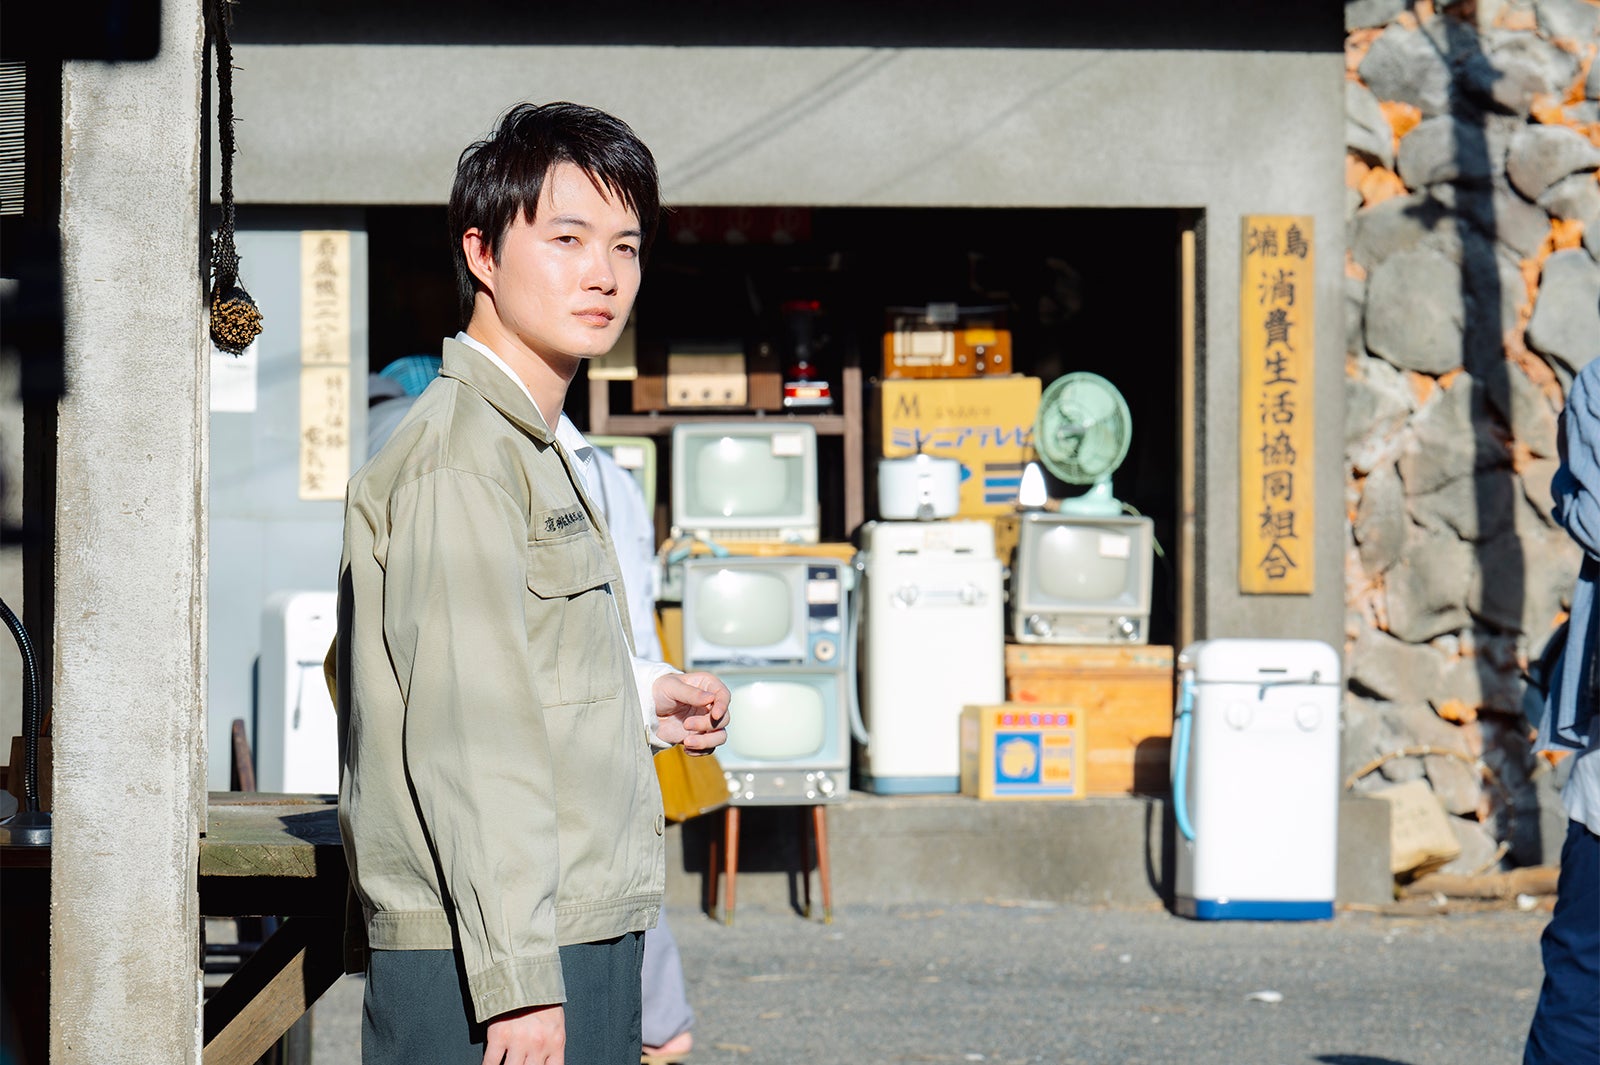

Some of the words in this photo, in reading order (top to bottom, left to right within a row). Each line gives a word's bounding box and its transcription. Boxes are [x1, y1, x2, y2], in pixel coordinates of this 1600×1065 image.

[1247, 222, 1309, 259] 端島
[1257, 268, 1299, 580] 消費生活協同組合
